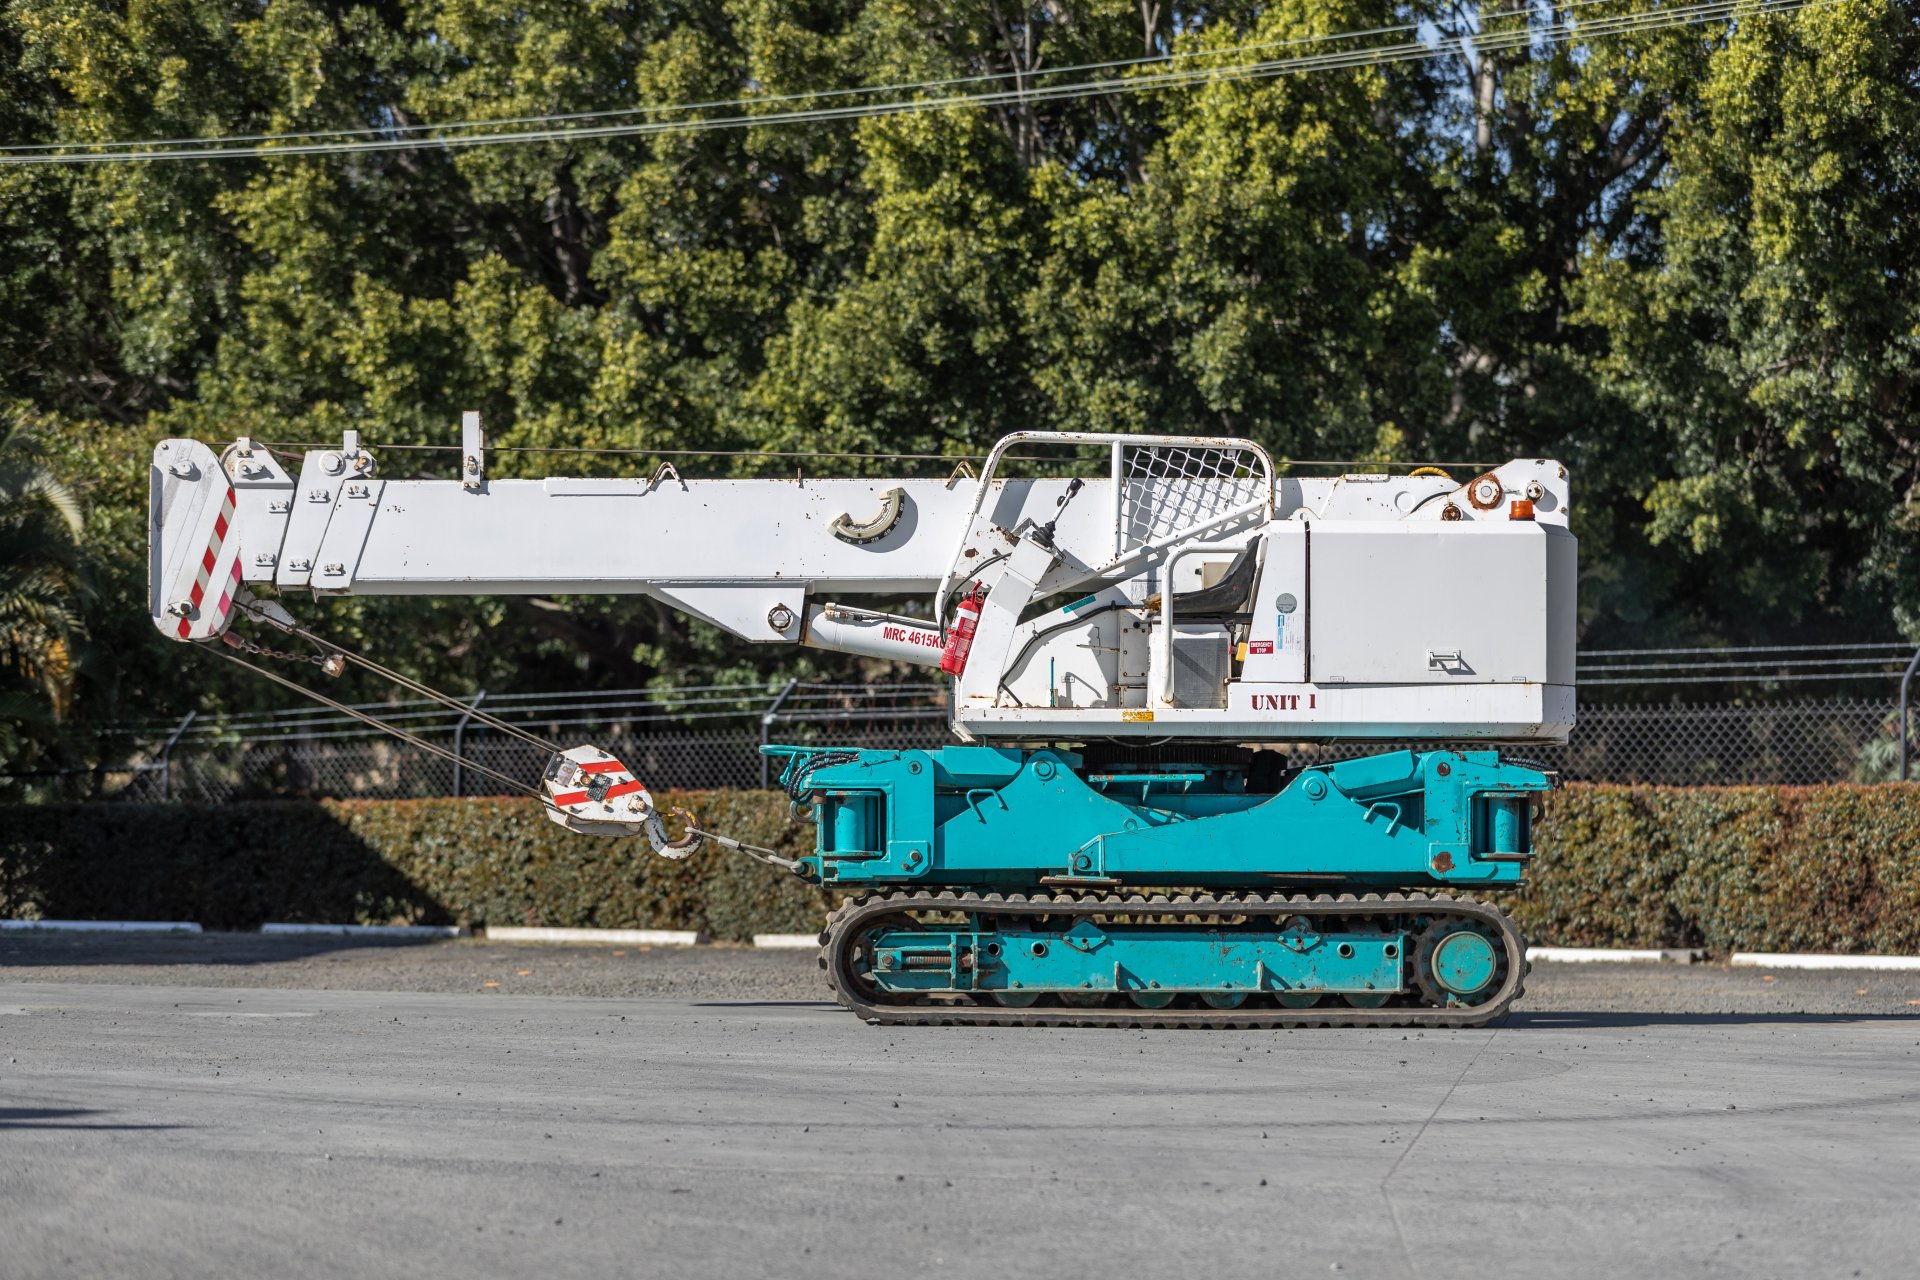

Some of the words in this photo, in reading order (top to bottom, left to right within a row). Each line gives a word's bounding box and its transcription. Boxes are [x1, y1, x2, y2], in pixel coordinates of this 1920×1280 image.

[883, 626, 906, 642] MRC
[1251, 695, 1300, 710] UNIT
[1309, 694, 1316, 709] 1
